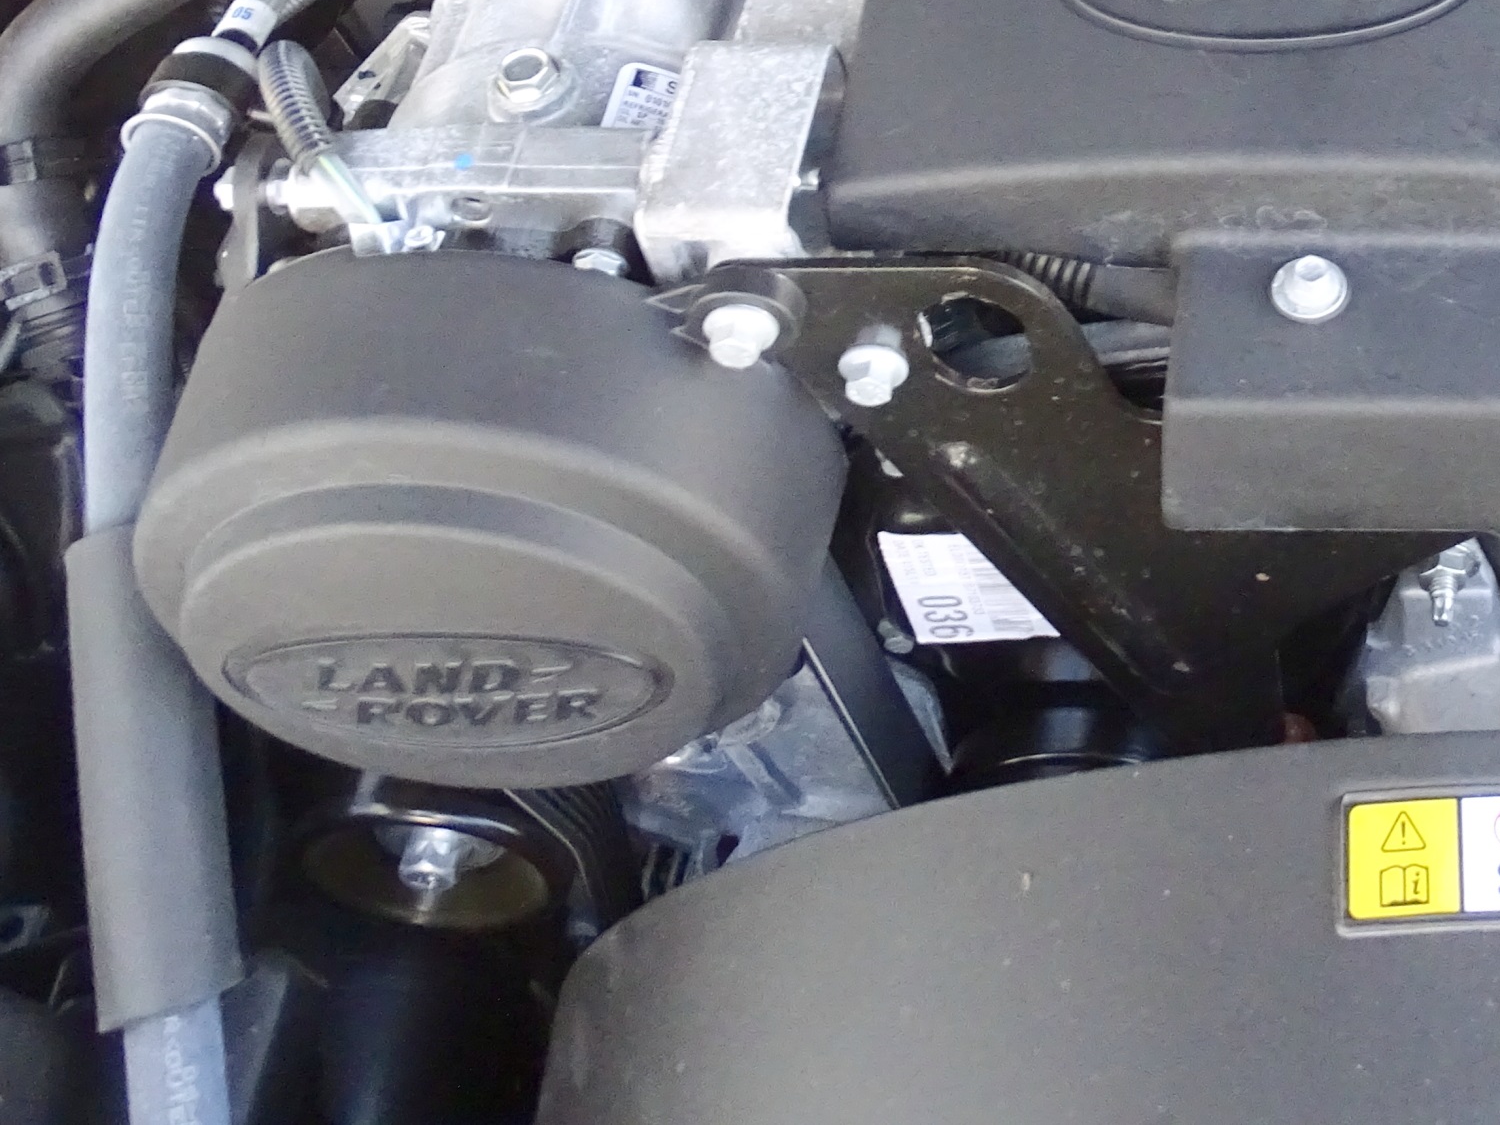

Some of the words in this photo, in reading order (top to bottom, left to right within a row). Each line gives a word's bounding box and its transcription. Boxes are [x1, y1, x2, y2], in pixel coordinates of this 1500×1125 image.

[917, 594, 975, 639] 036
[317, 656, 522, 695] LAND
[356, 688, 602, 726] ROVER
